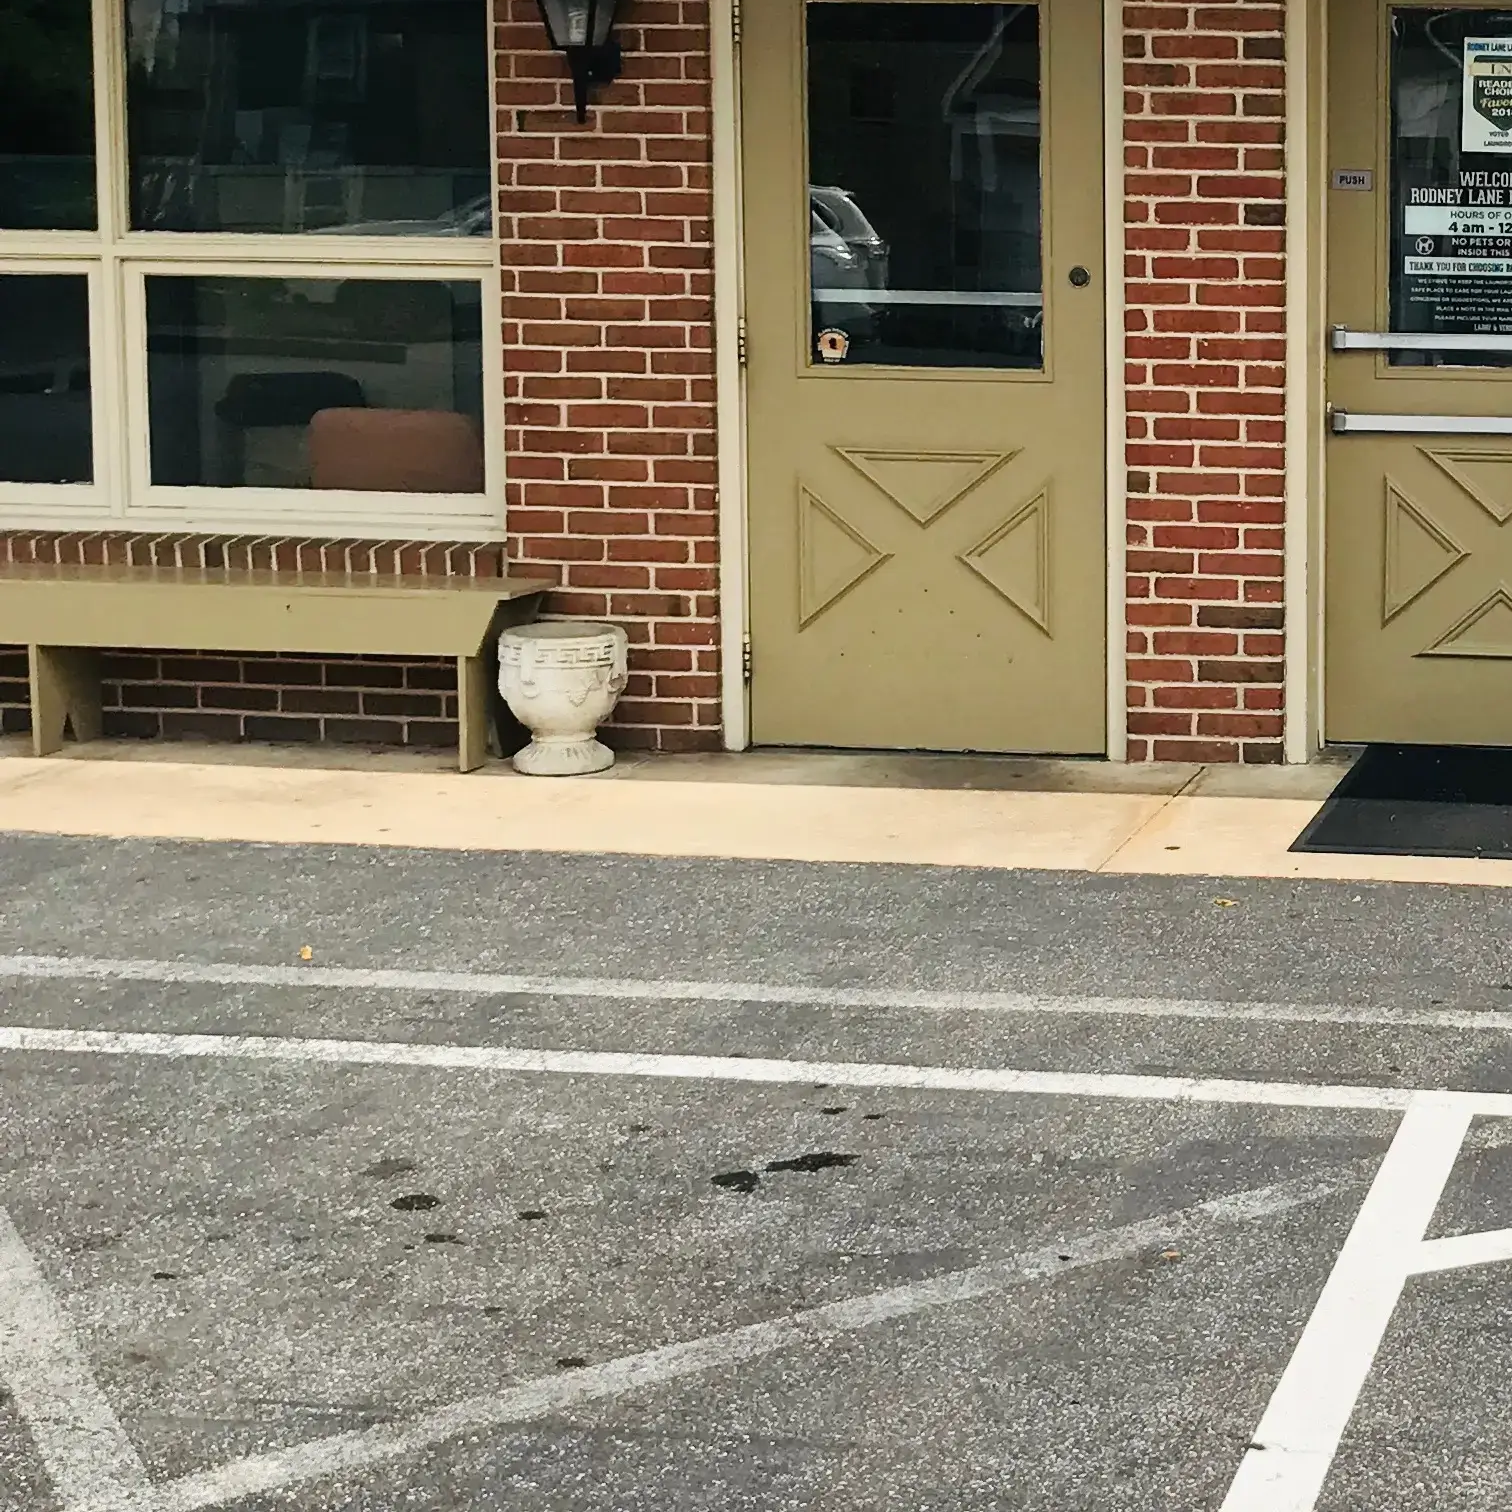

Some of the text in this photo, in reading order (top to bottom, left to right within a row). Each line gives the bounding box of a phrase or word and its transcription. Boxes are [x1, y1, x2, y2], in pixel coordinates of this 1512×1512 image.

[1339, 175, 1365, 185] PUSH
[1410, 187, 1463, 204] RODNEY
[1468, 189, 1504, 205] LANE
[1450, 211, 1485, 219] HOURS
[1487, 211, 1502, 219] OF
[1448, 221, 1458, 233] 4
[1461, 223, 1485, 233] am
[1451, 237, 1467, 246] NO
[1469, 238, 1494, 246] PETS
[1495, 238, 1512, 247] OR
[1457, 248, 1488, 257] INSIDE
[1490, 248, 1510, 257] THIS
[1436, 262, 1451, 272] YOU
[1452, 262, 1467, 272] FOR
